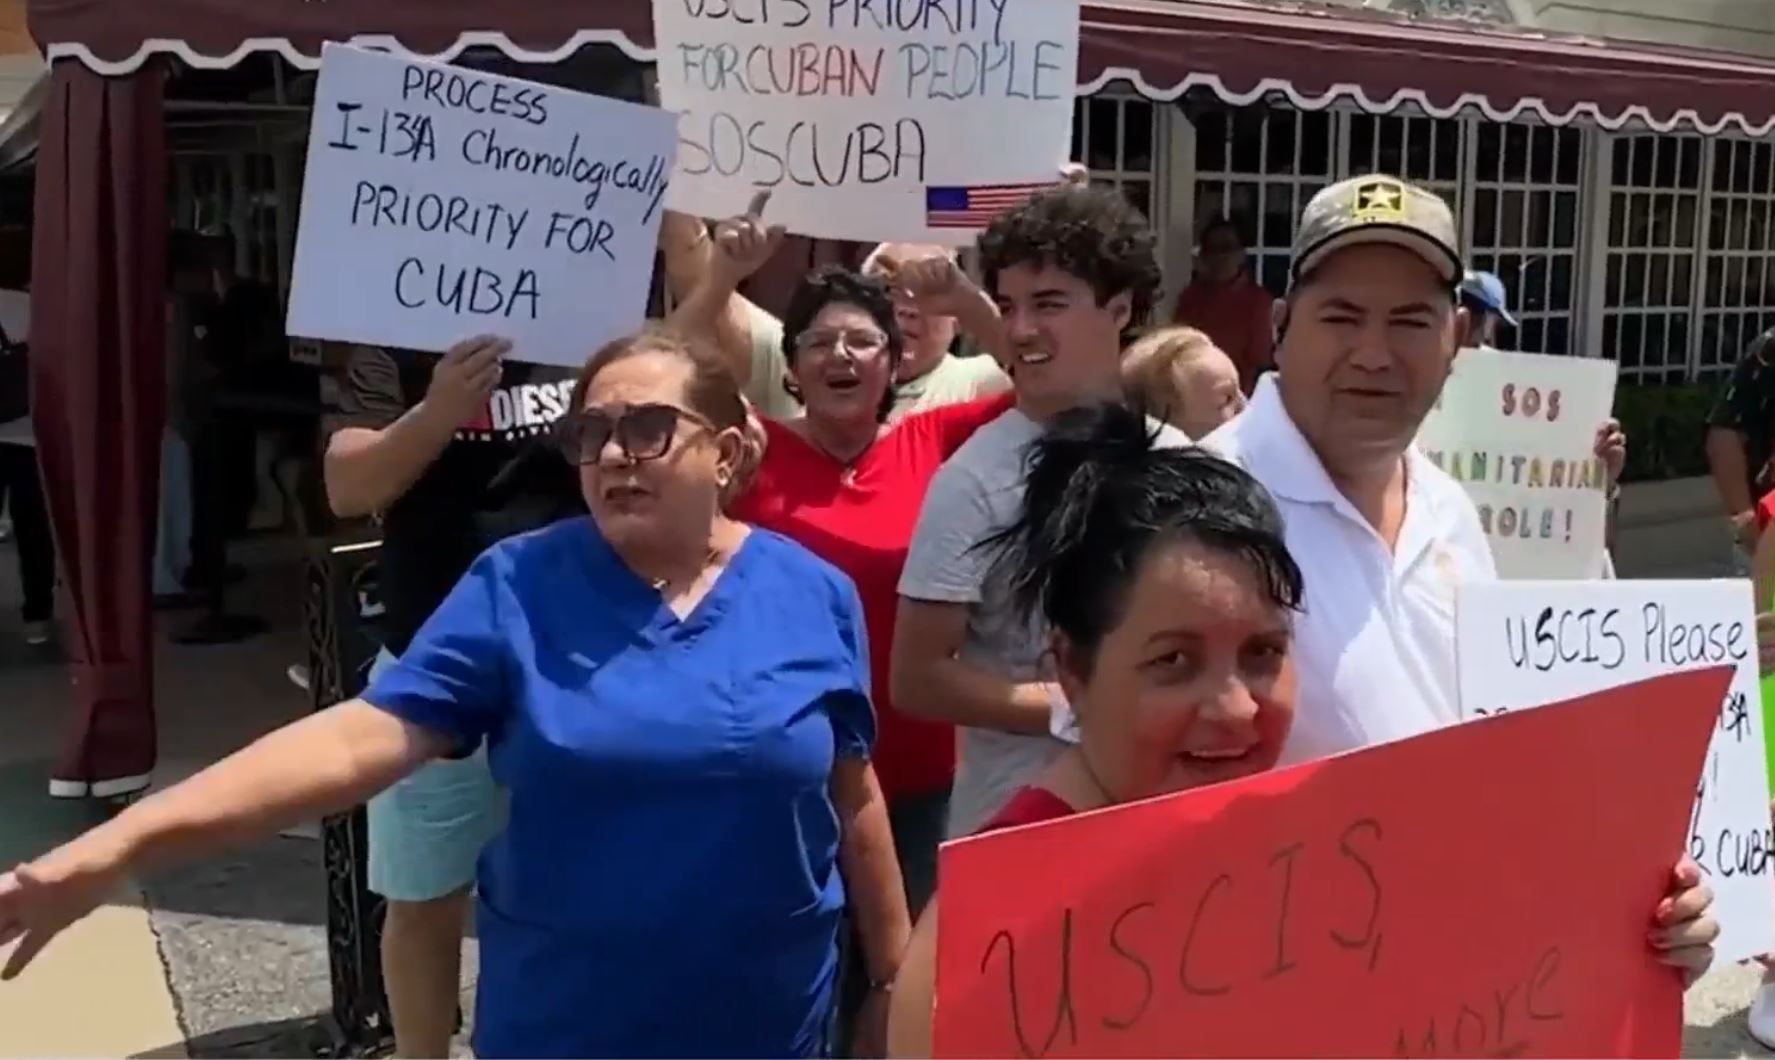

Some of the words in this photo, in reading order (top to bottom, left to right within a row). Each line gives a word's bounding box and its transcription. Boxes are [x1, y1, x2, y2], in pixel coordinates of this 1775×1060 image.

[402, 65, 548, 125] PROCESS
[898, 39, 1065, 101] PEOPLE
[462, 133, 668, 225] Chronologically
[351, 180, 529, 250] PRIORITY
[544, 212, 617, 261] FOR
[394, 257, 541, 319] CUBA
[490, 379, 578, 431] DIESE
[1502, 383, 1561, 422] SOS
[1506, 606, 1626, 671] USCIS
[1641, 602, 1748, 665] Please
